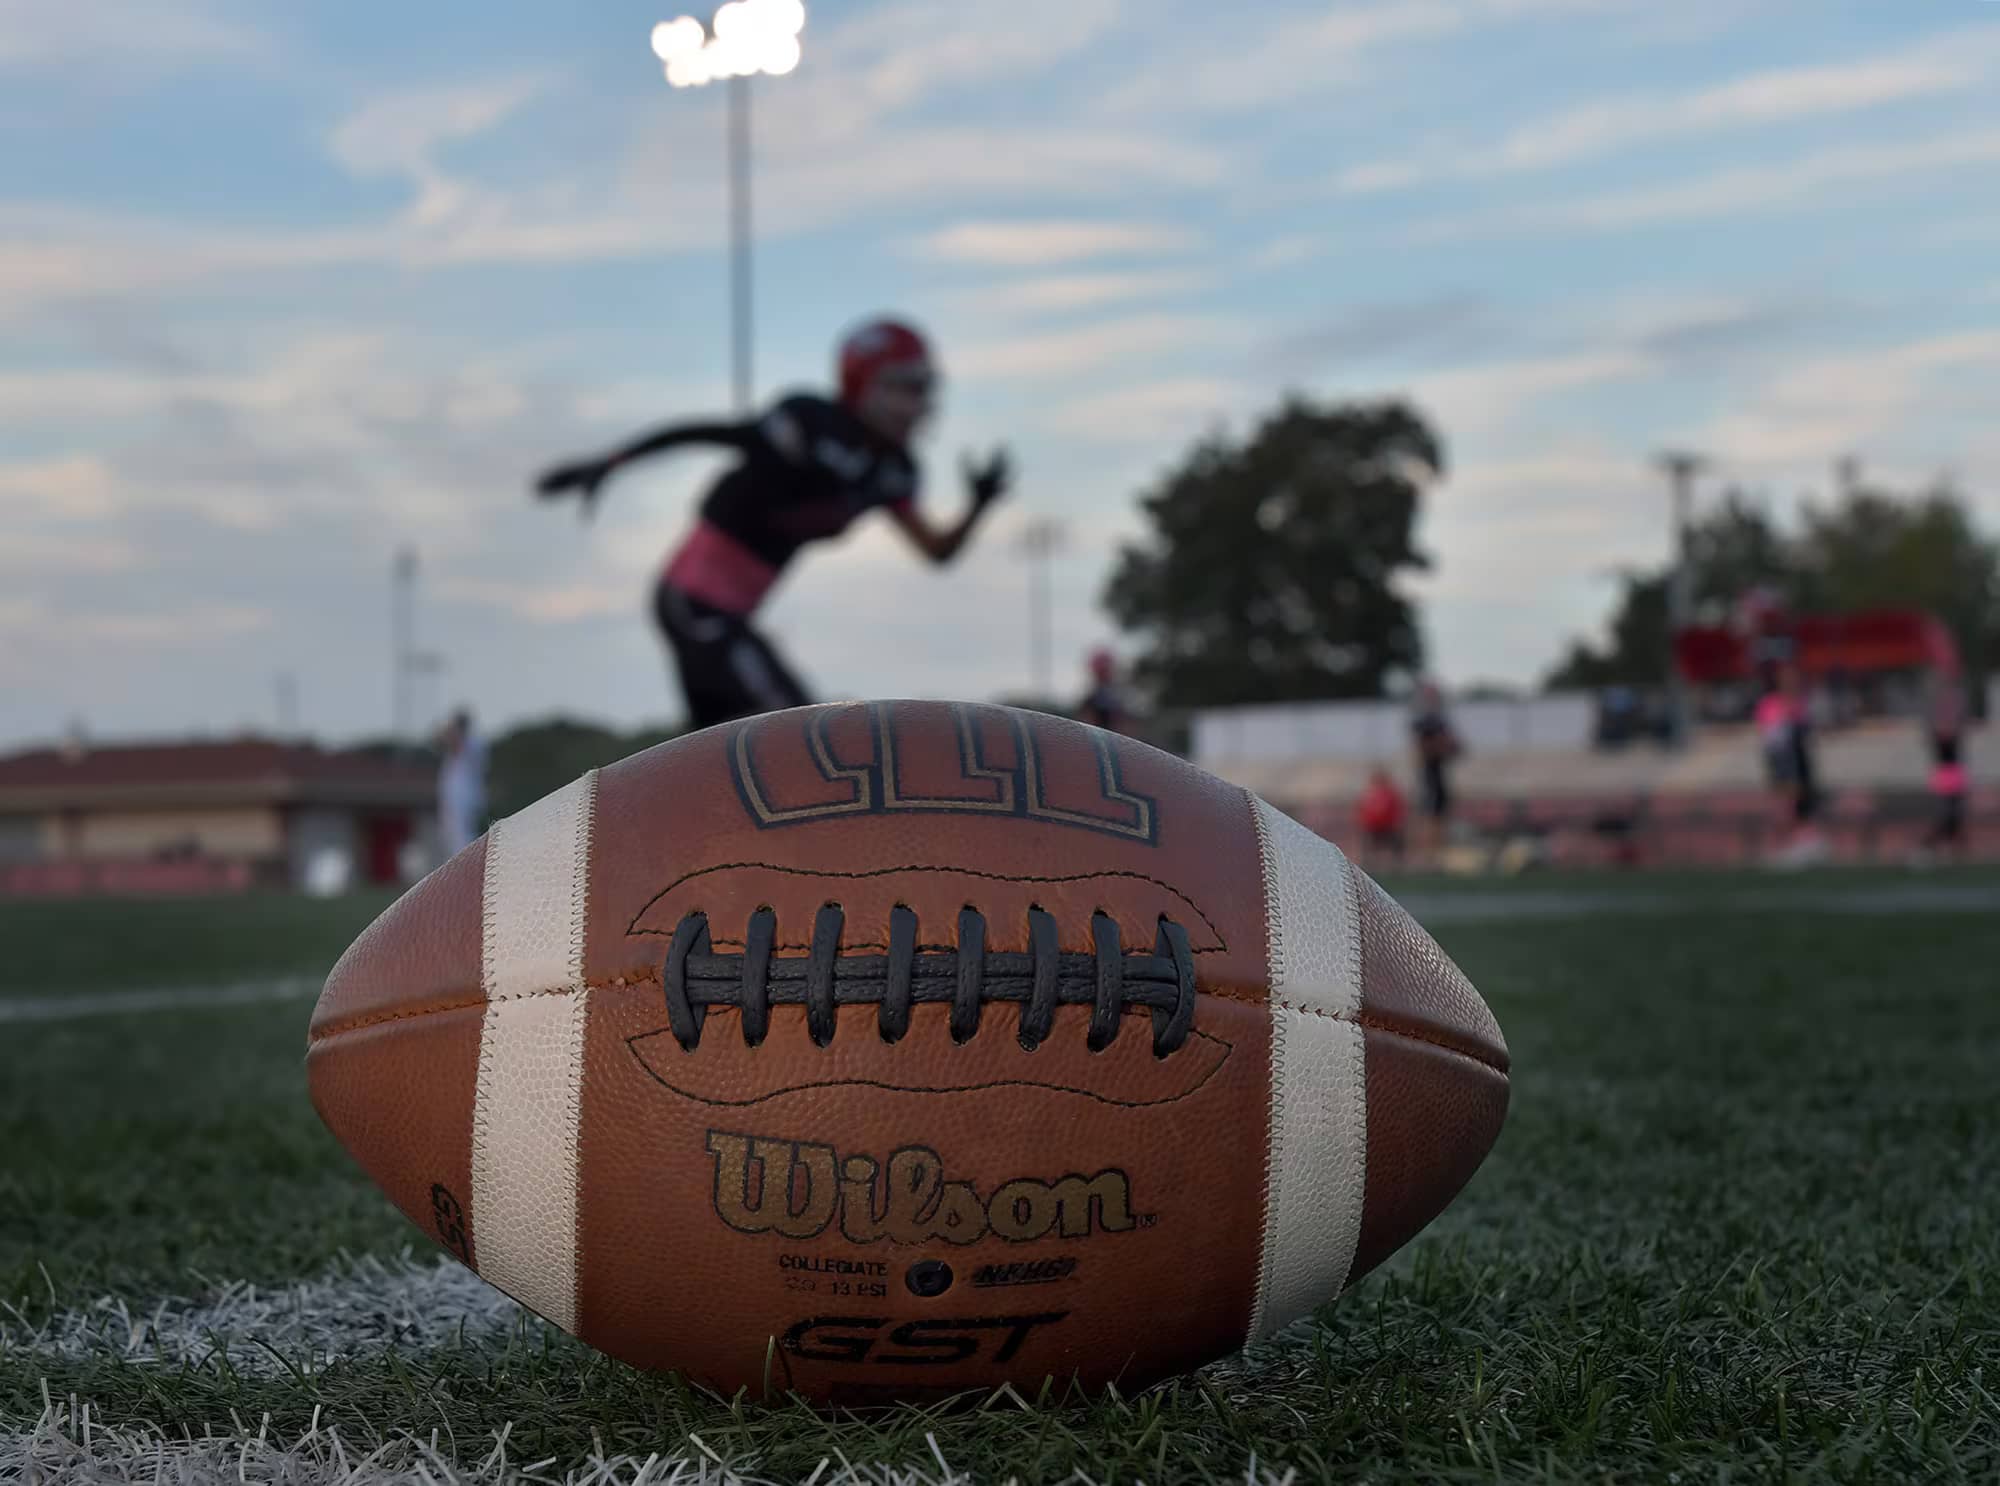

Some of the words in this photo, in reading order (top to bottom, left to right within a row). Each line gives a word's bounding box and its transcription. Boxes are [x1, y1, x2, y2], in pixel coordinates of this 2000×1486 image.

[705, 1128, 1138, 1245] Wilson
[779, 1253, 888, 1276] COLLEGIATE
[782, 1310, 1070, 1364] GST
